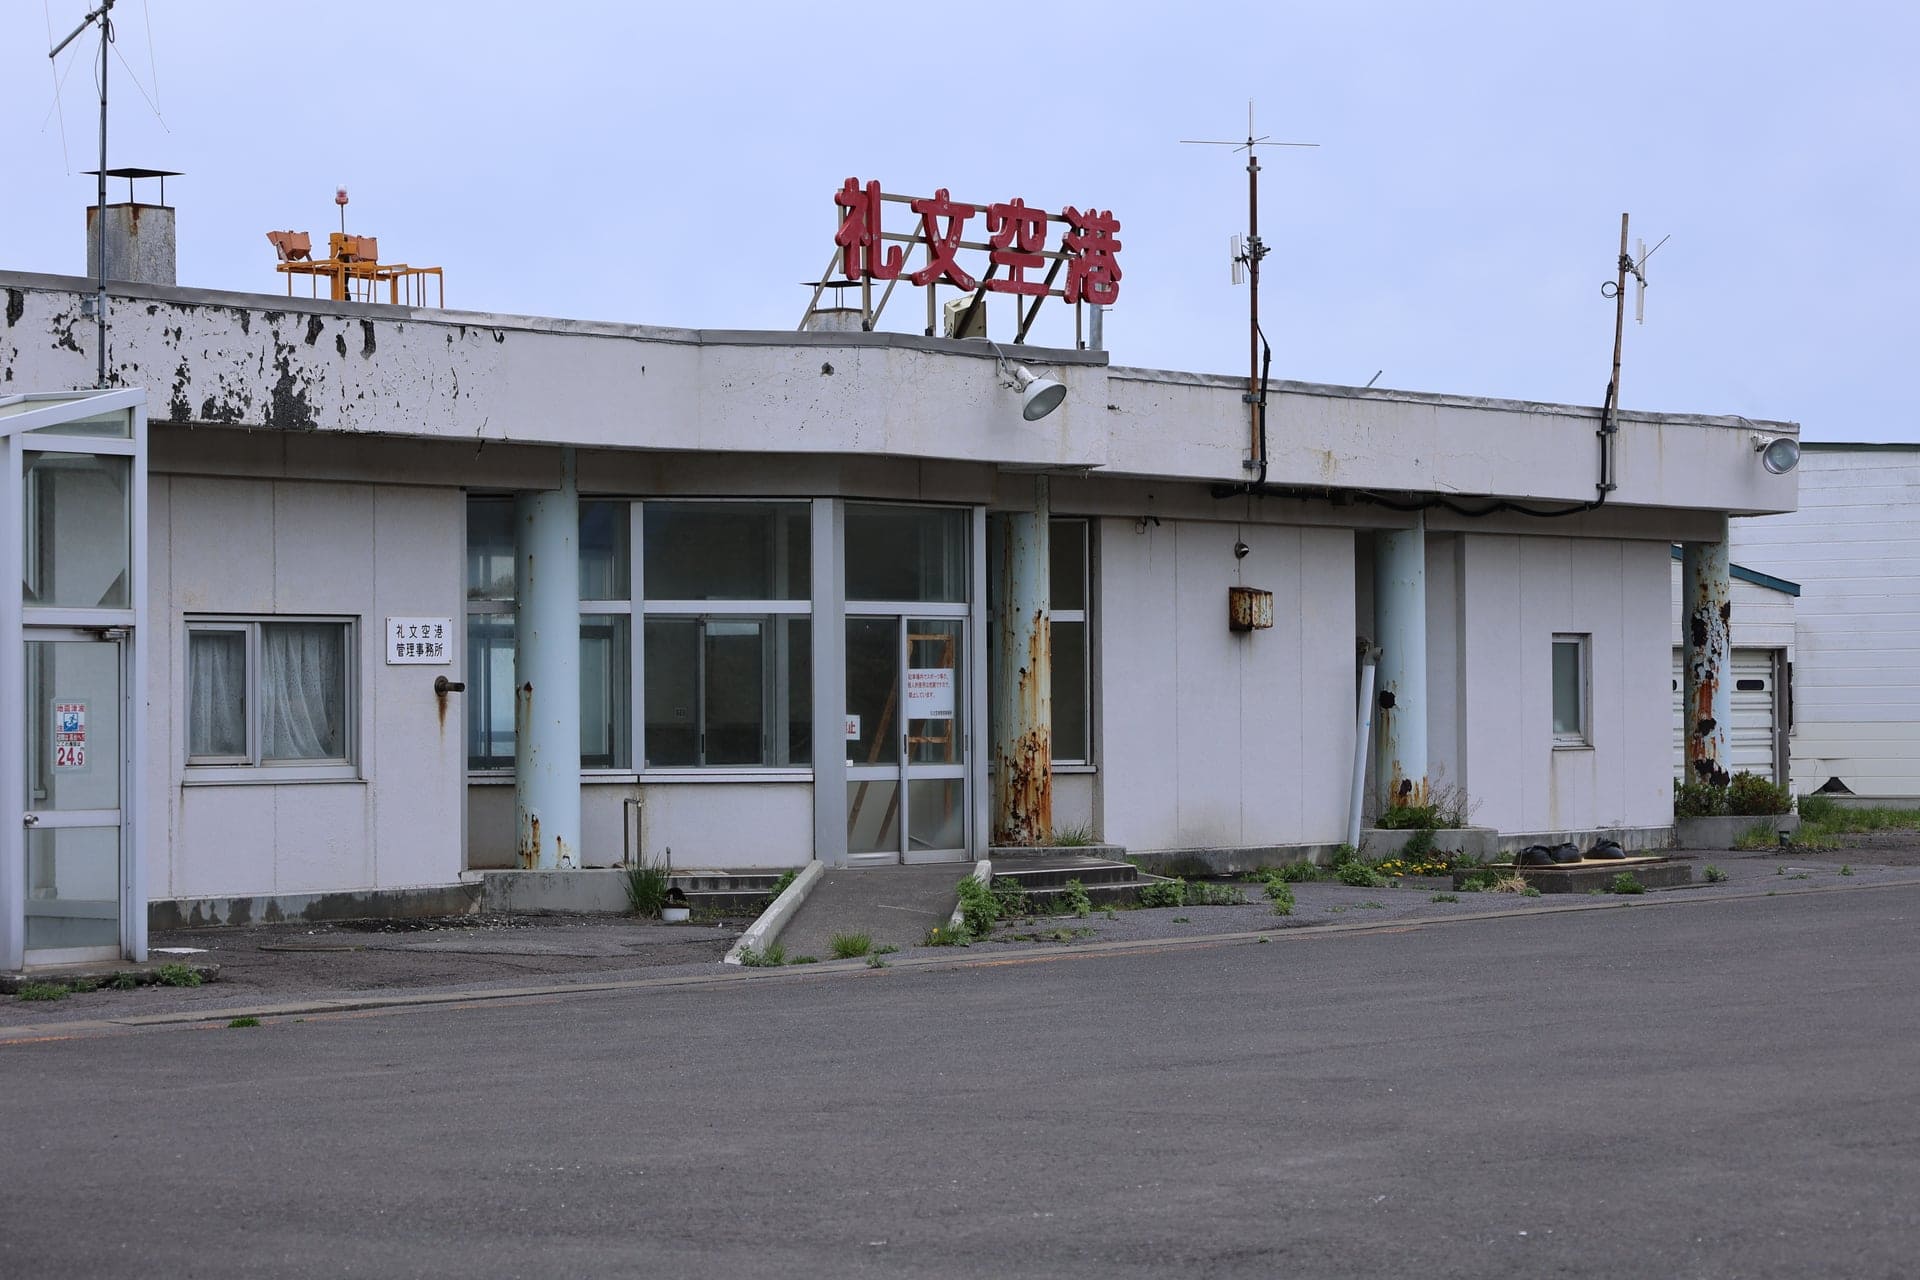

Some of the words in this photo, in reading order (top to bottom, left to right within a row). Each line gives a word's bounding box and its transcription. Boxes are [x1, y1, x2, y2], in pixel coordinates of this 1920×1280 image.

[834, 177, 1122, 304] 礼文空港
[396, 624, 443, 639] 礼文空港
[396, 642, 443, 657] 管理事務所
[57, 747, 84, 766] 24.9
